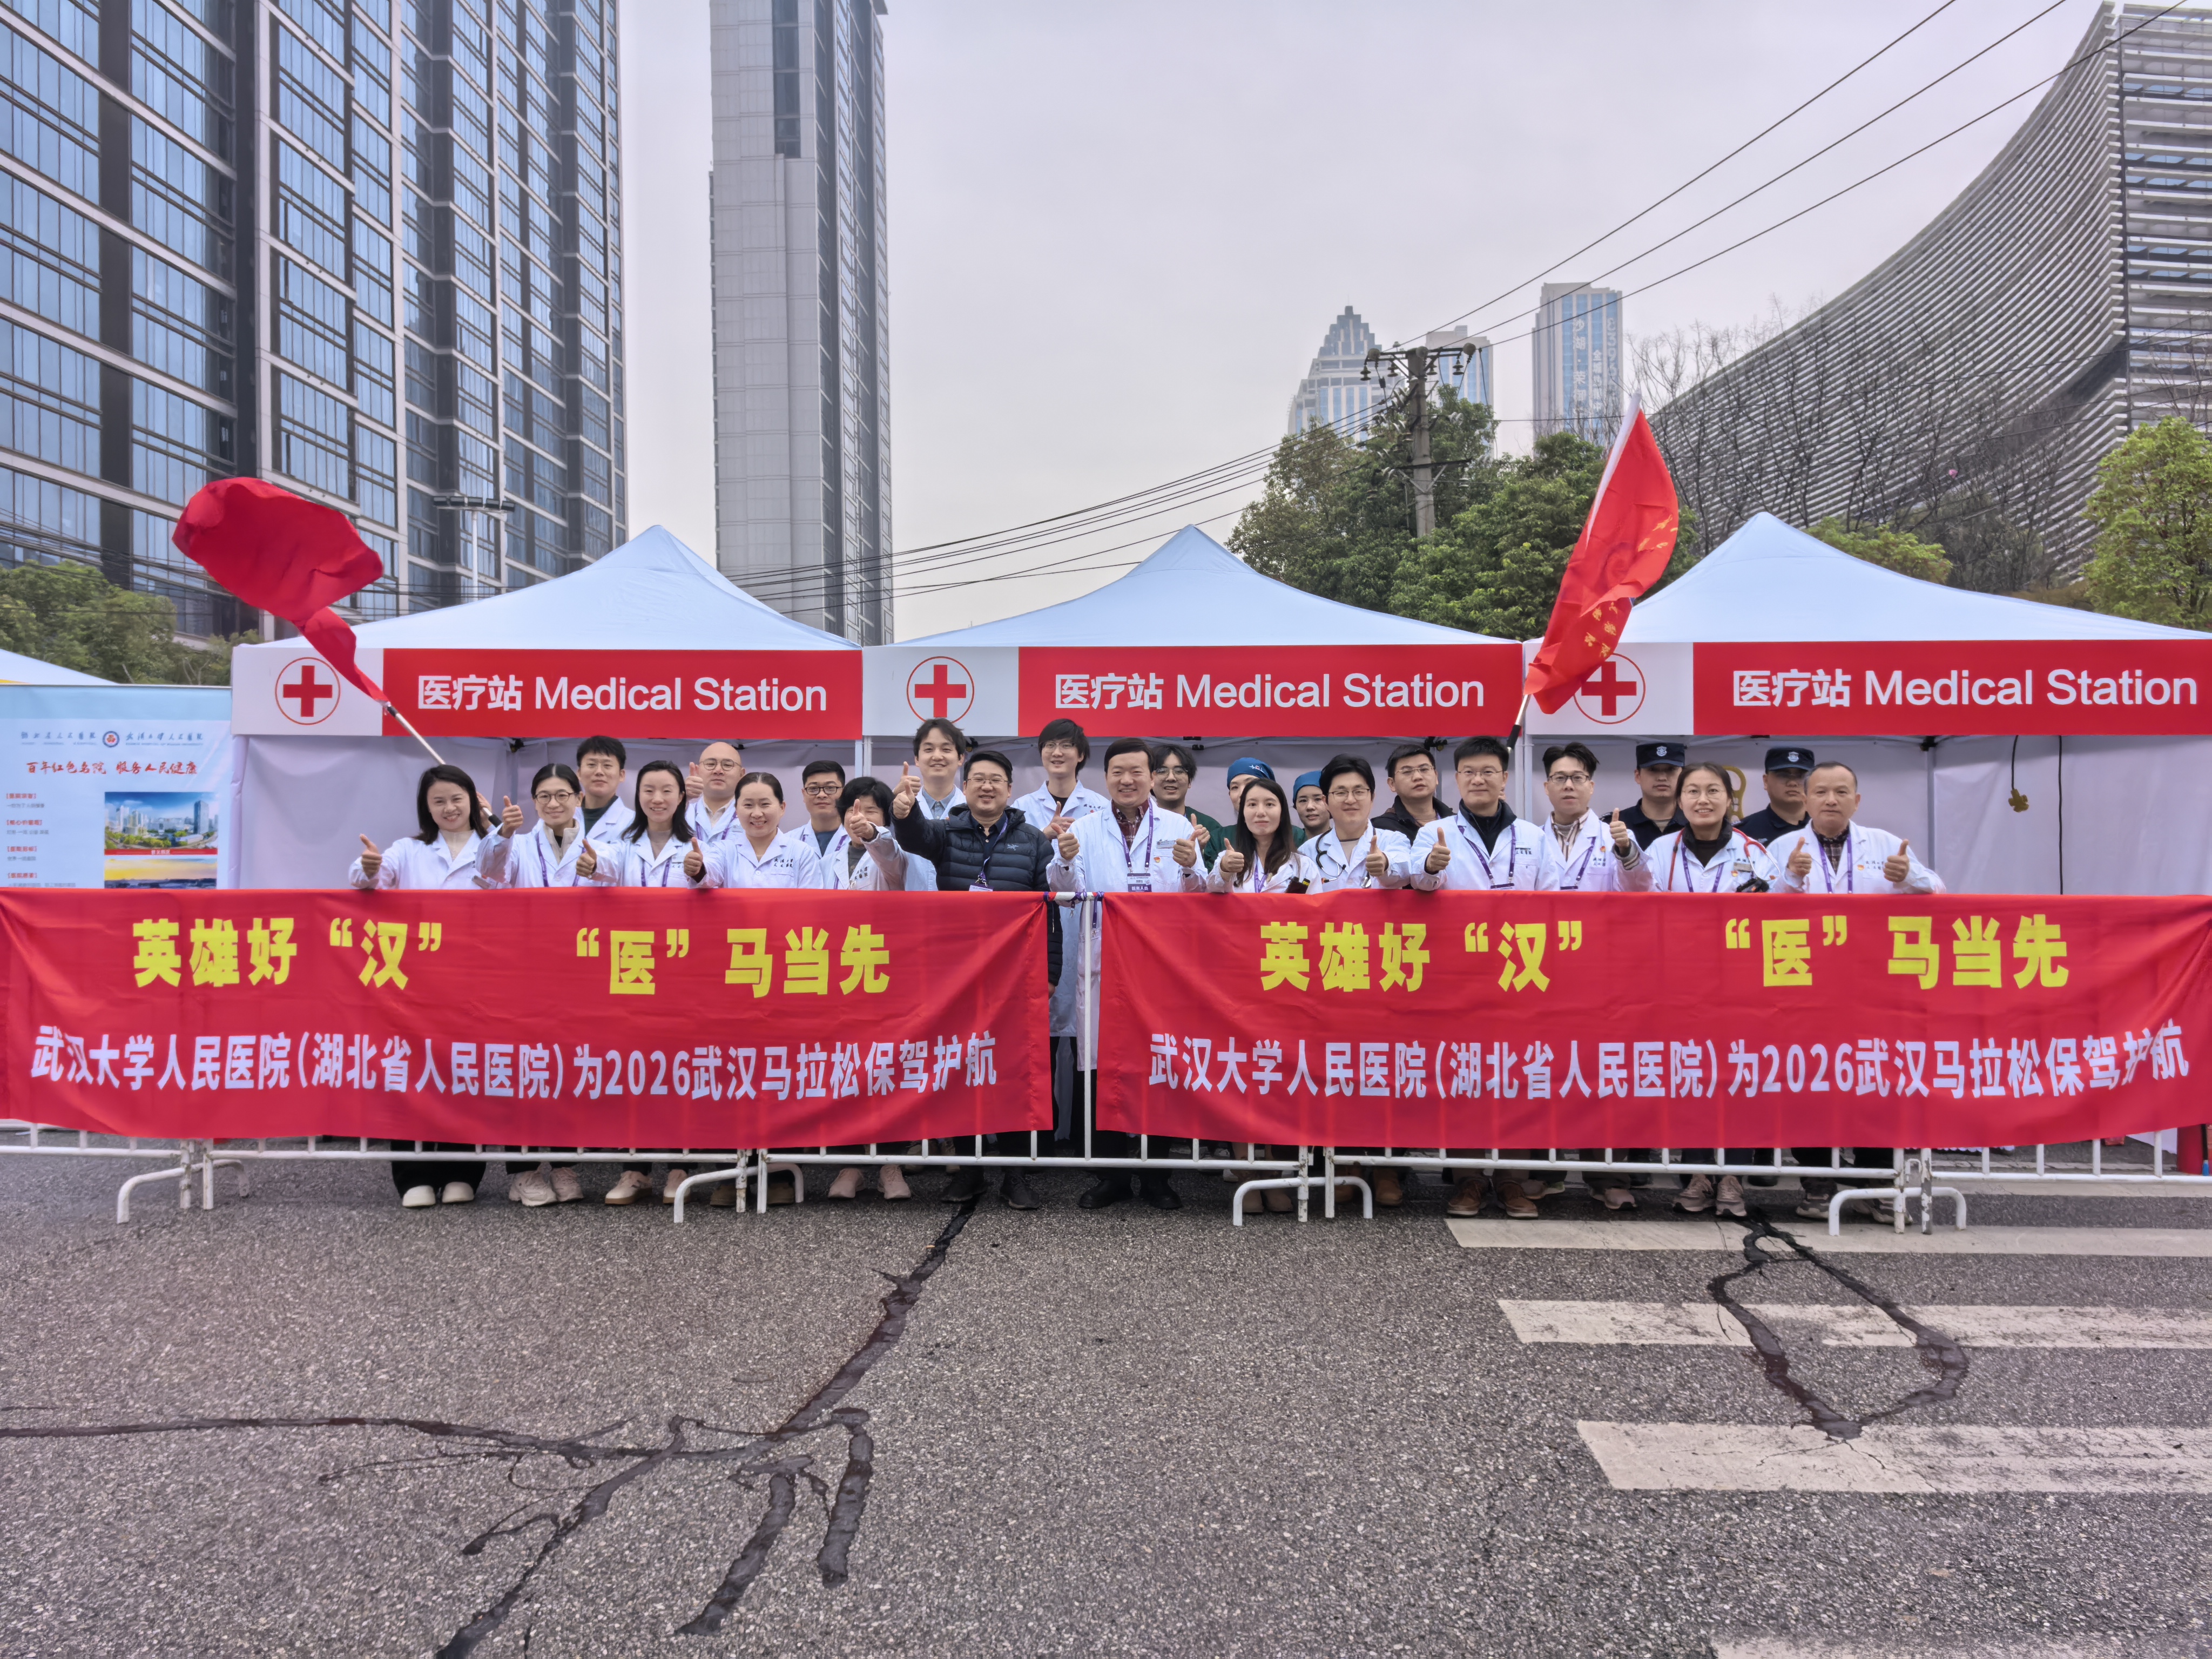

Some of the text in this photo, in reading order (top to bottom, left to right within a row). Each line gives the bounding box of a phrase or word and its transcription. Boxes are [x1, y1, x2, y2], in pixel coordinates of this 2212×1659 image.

[417, 675, 826, 711] 医疗站 Medical Station
[1055, 672, 1484, 710] 医疗站 Medical Station
[1733, 669, 2197, 707] 医疗站 Medical Station
[26, 761, 197, 774] 百年红色名院 服务人民健康
